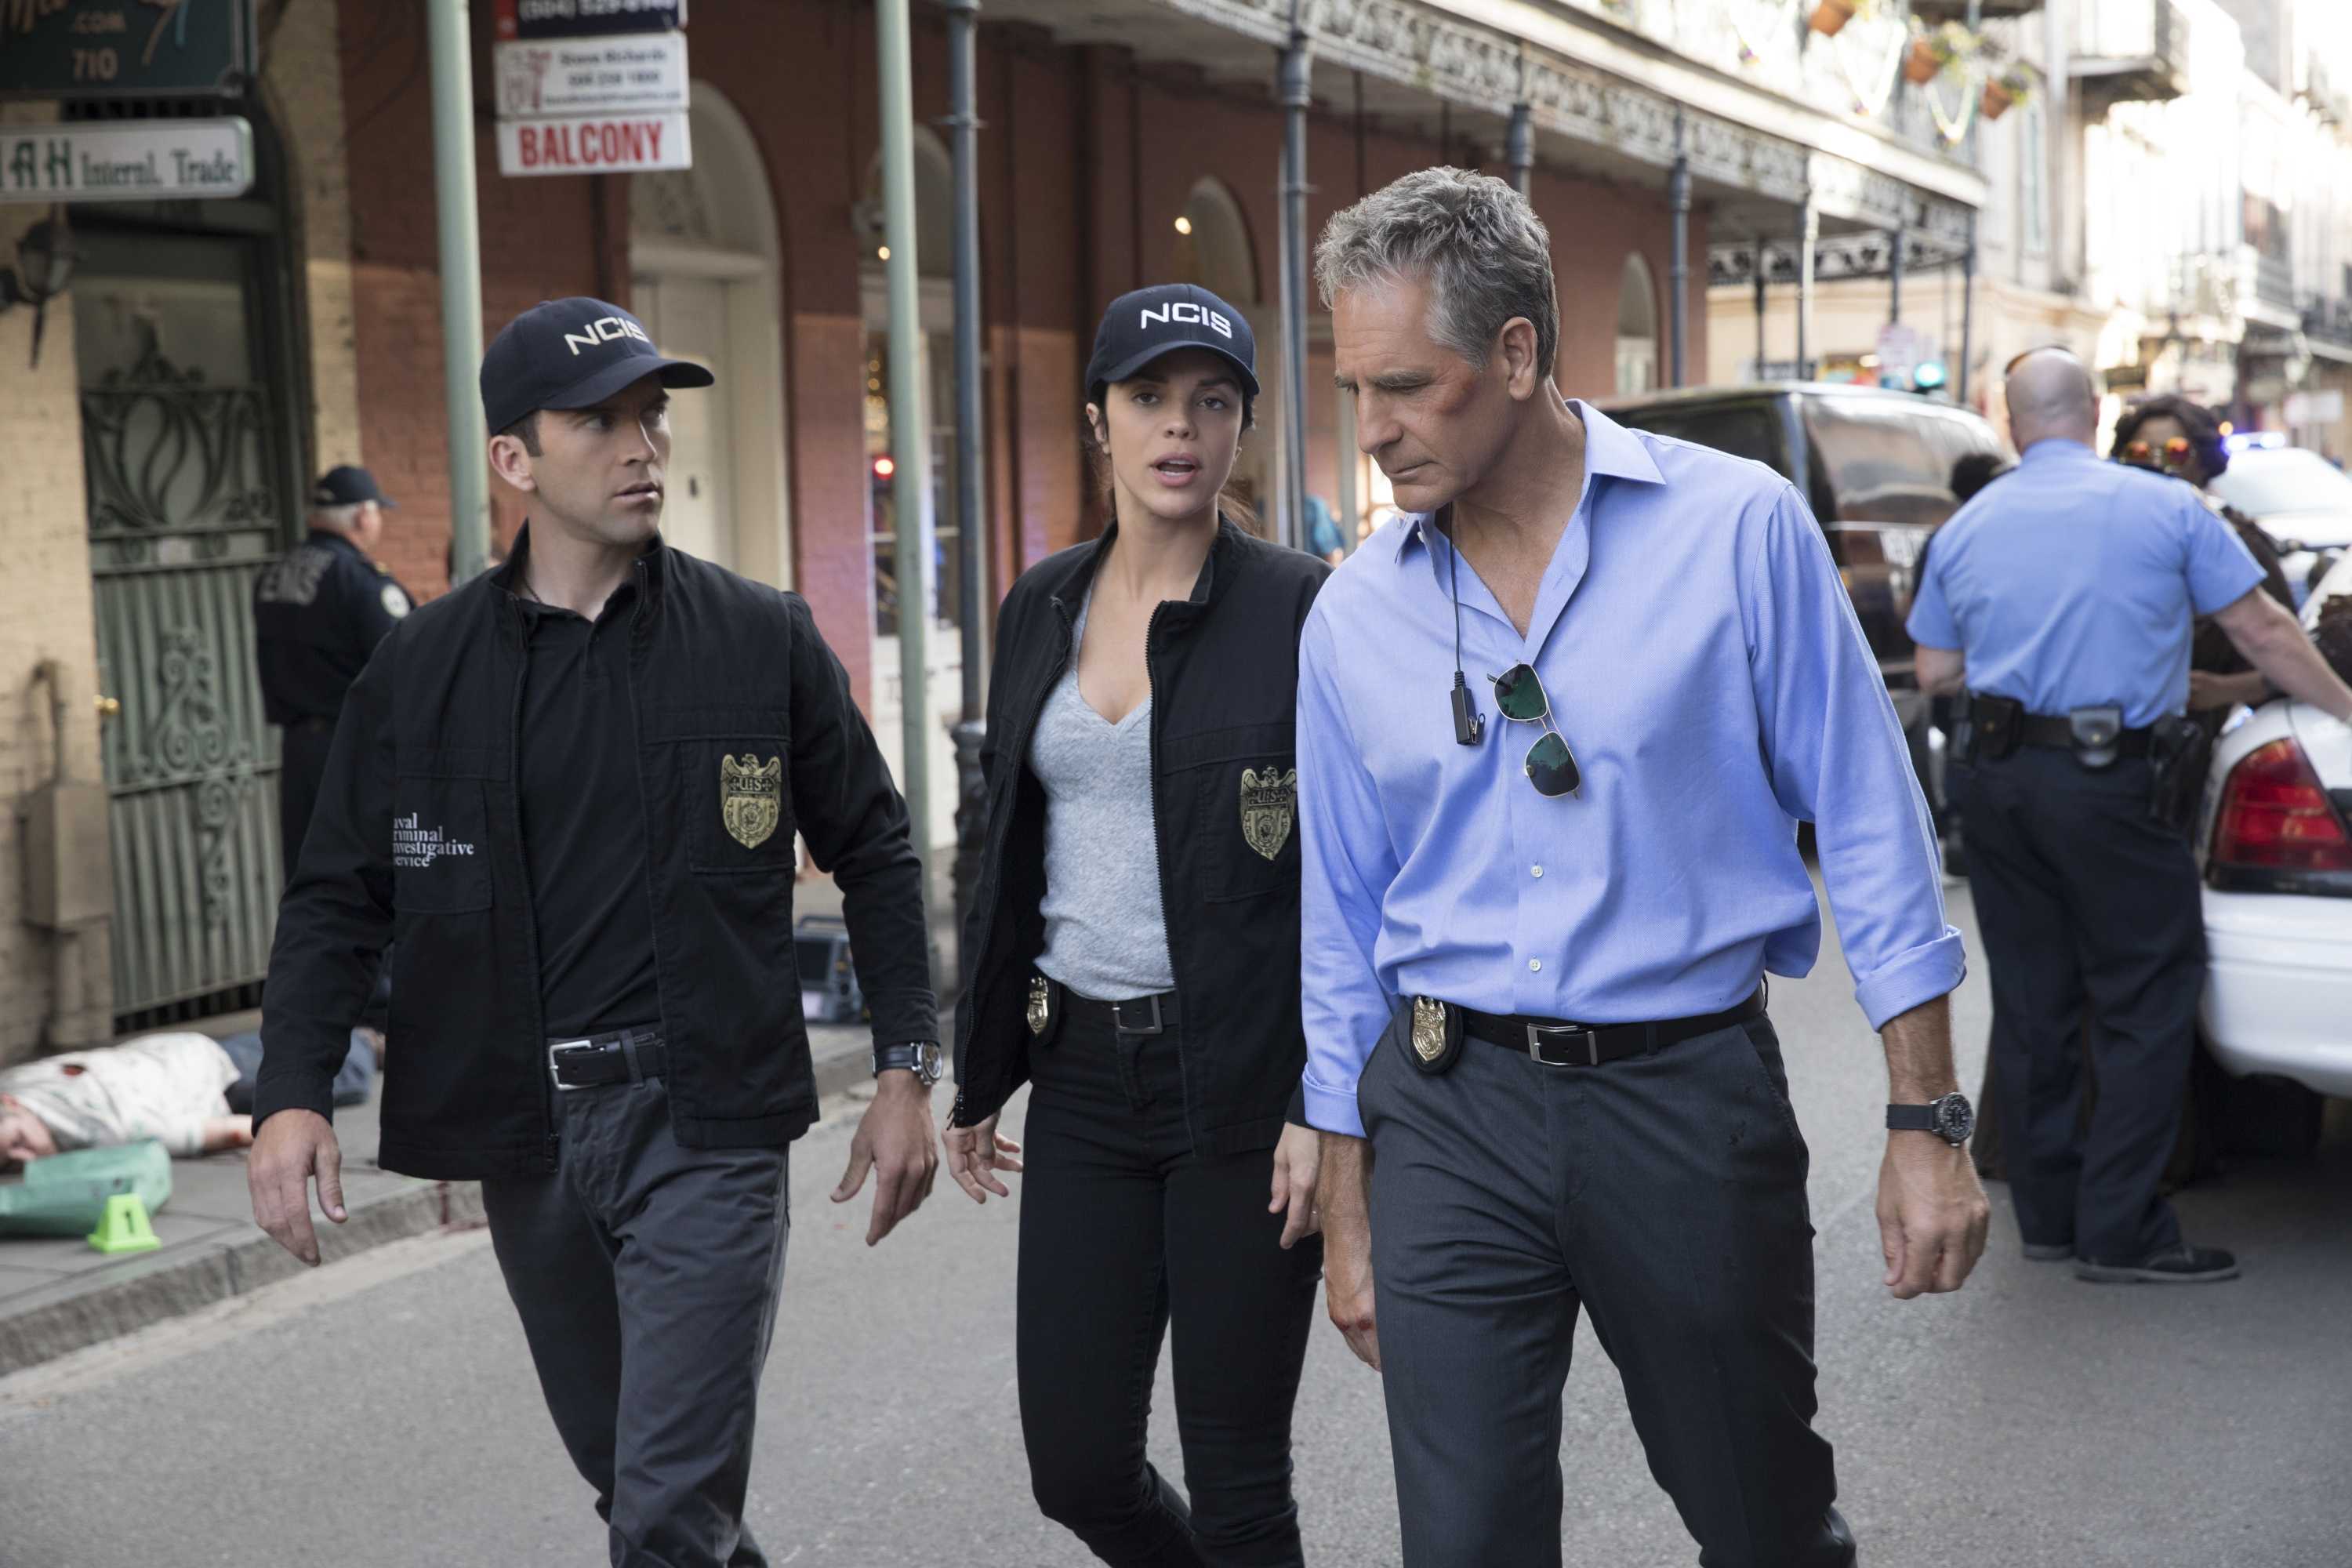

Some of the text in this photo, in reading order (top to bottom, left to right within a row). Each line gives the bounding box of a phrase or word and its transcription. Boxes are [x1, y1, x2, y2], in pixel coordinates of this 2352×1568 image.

[73, 48, 118, 80] 710
[518, 122, 662, 168] BALCONY
[170, 149, 234, 186] Trade
[564, 316, 650, 355] NCIS
[1141, 303, 1232, 339] NCIS
[123, 1210, 135, 1235] 1
